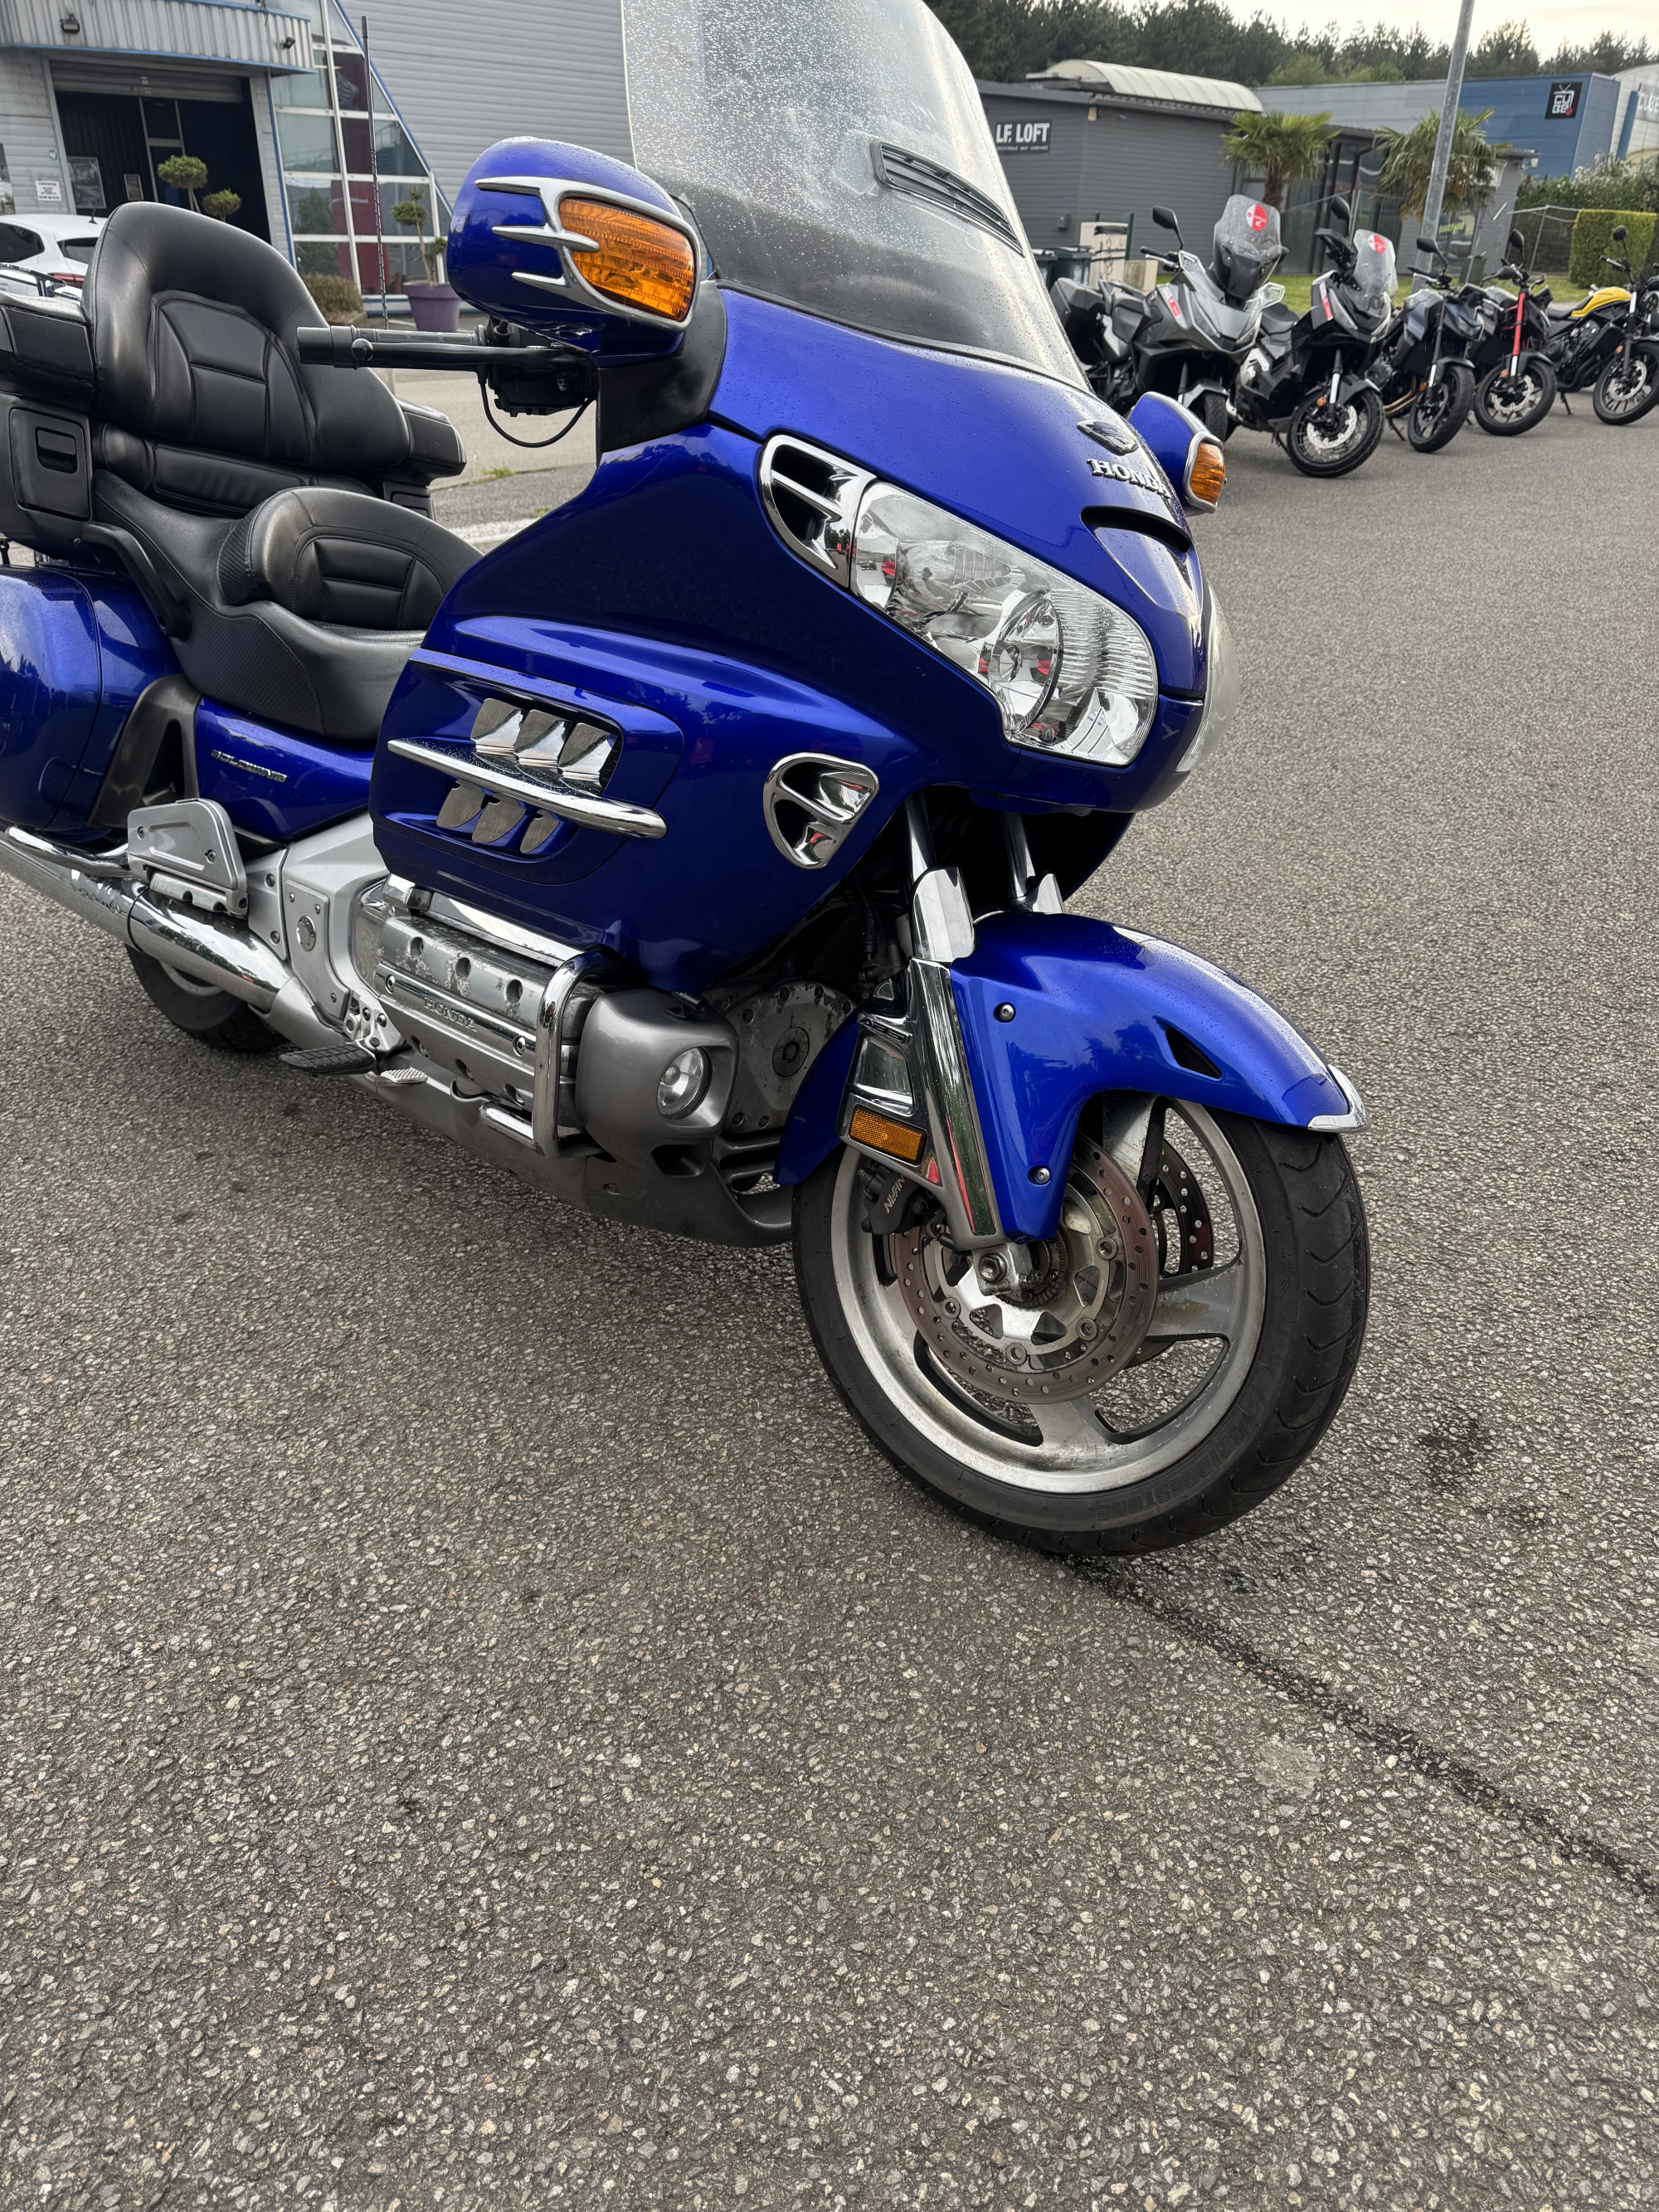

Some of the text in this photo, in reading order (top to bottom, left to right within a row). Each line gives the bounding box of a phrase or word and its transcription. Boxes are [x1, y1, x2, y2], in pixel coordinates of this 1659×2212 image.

[1016, 122, 1050, 143] LOFT
[1087, 458, 1172, 498] HONDA
[424, 997, 478, 1033] HONDA
[1097, 1421, 1249, 1521] BRIDGESTONE
